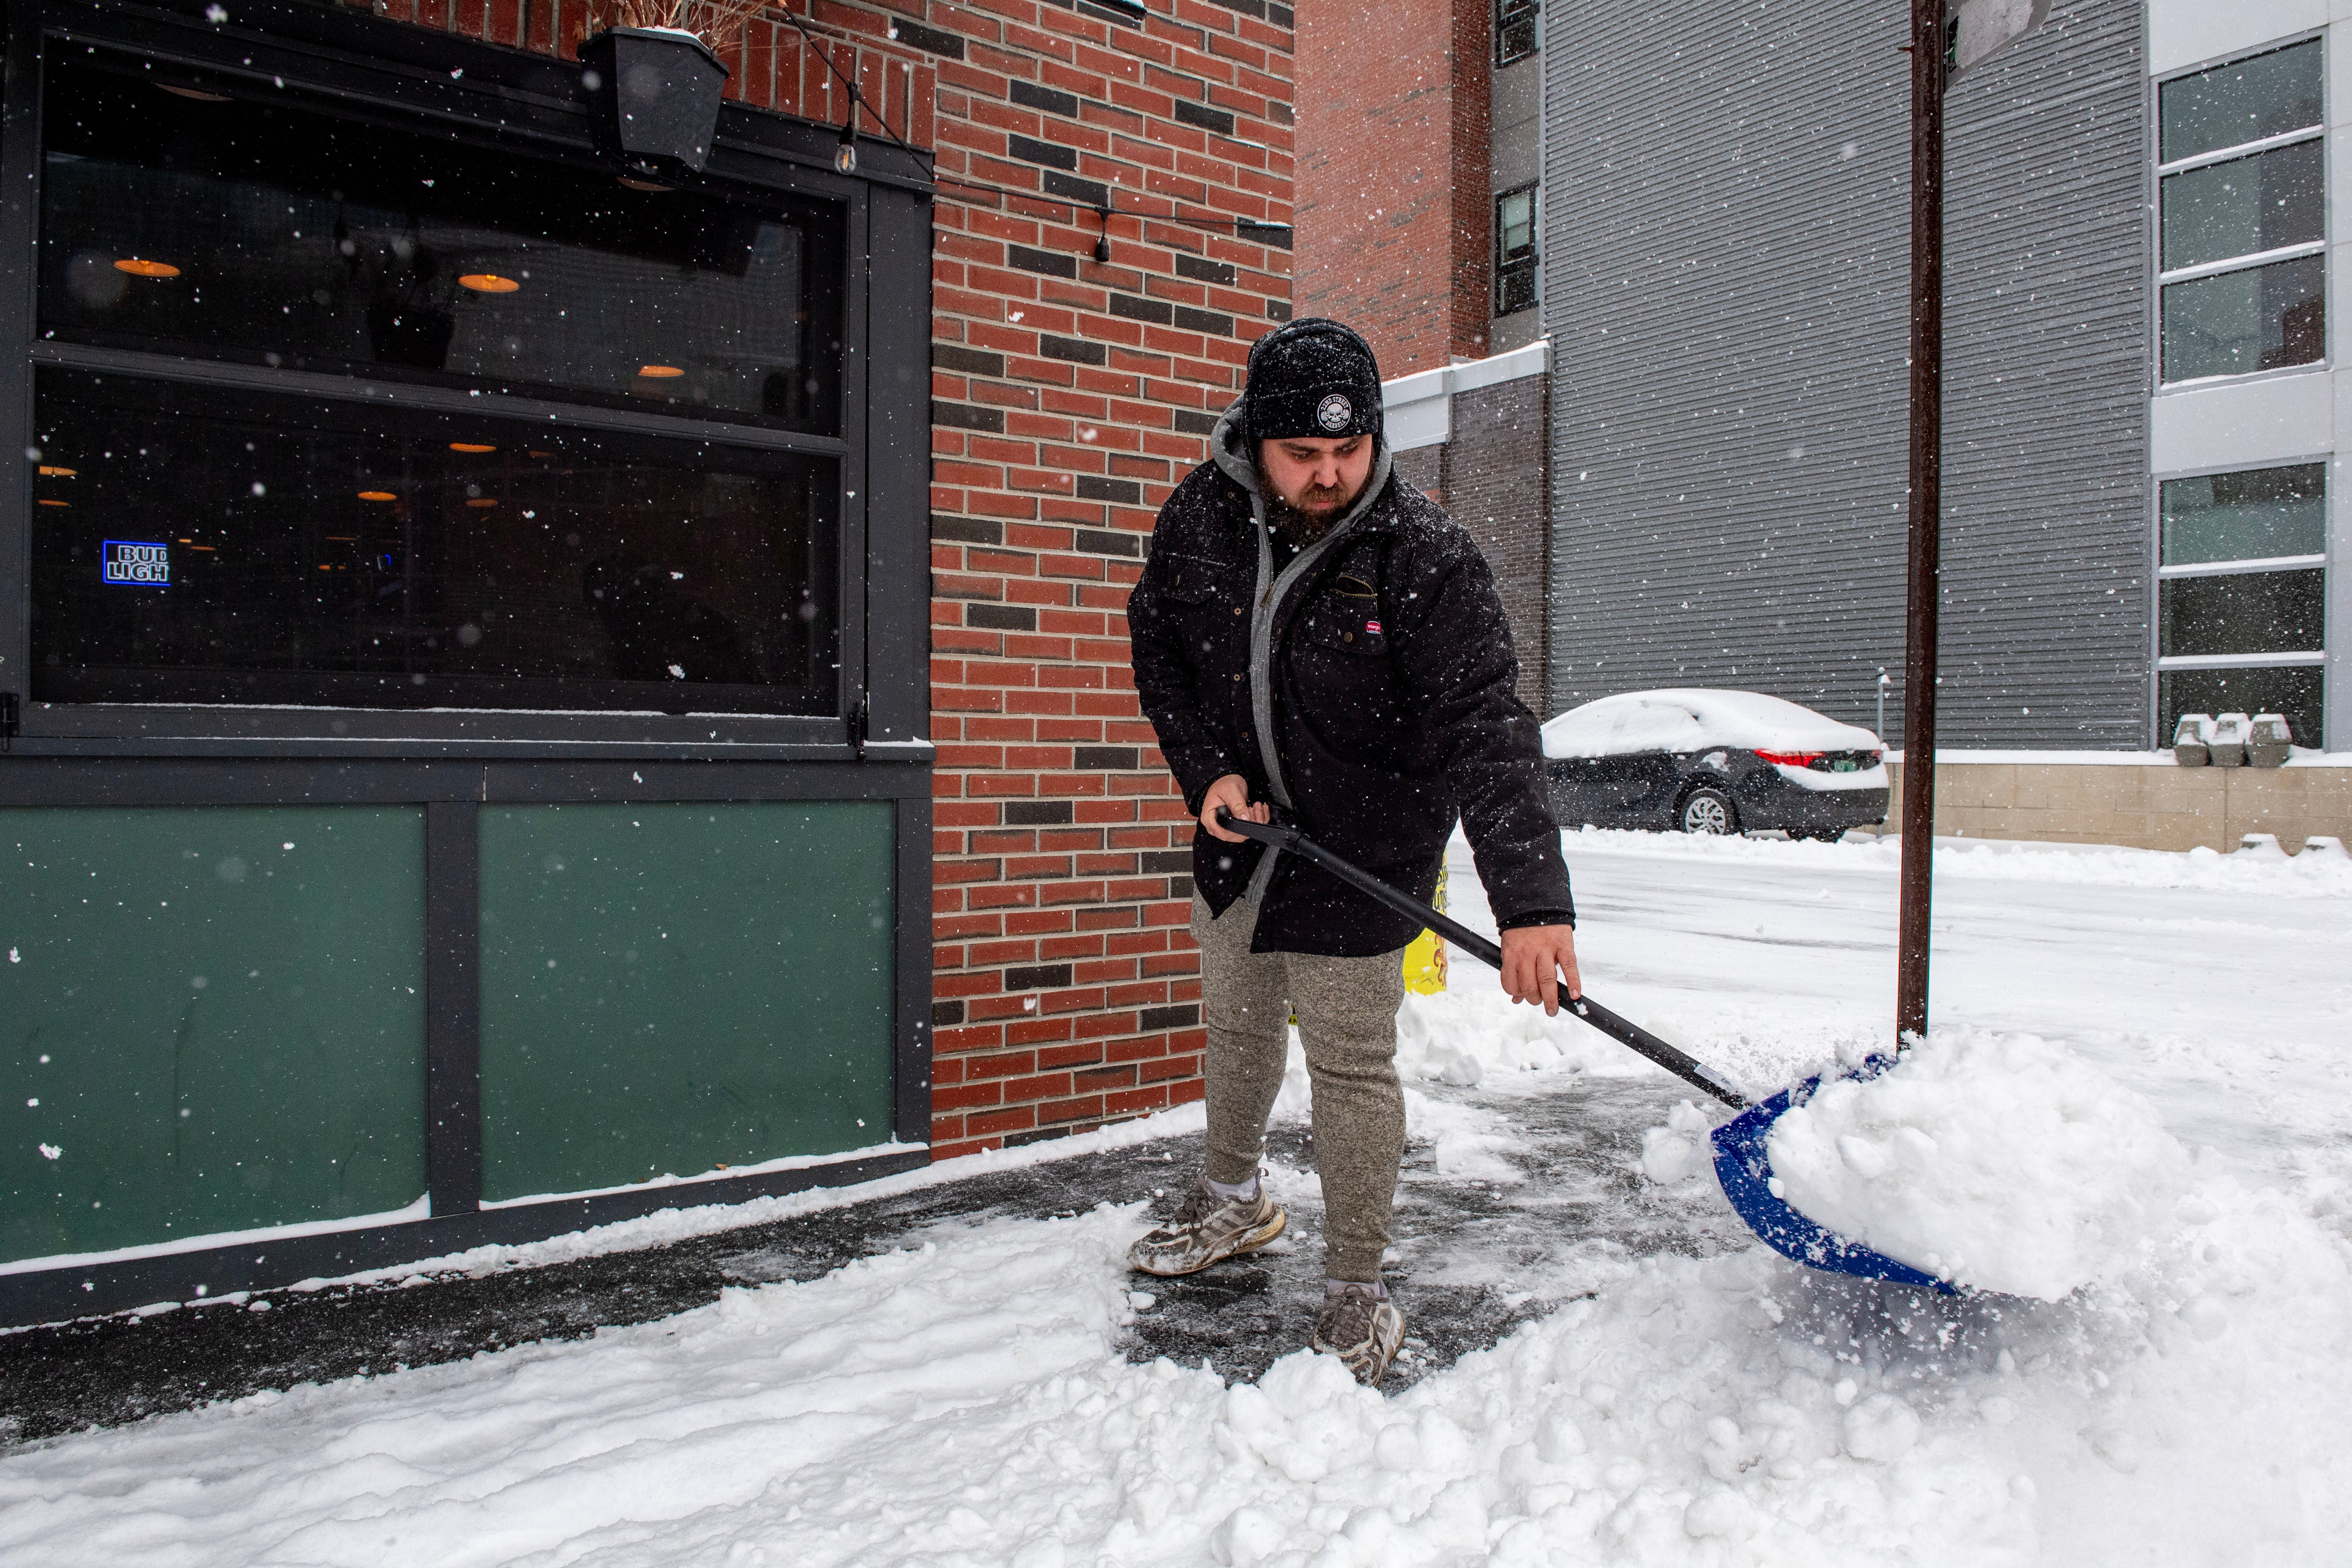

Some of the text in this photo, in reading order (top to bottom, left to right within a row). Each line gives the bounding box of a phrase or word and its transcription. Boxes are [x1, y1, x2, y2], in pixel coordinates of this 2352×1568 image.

[1333, 397, 1348, 408] STREET
[1326, 420, 1346, 428] BARBELL
[118, 545, 168, 564] BUD
[107, 562, 169, 582] LIGH
